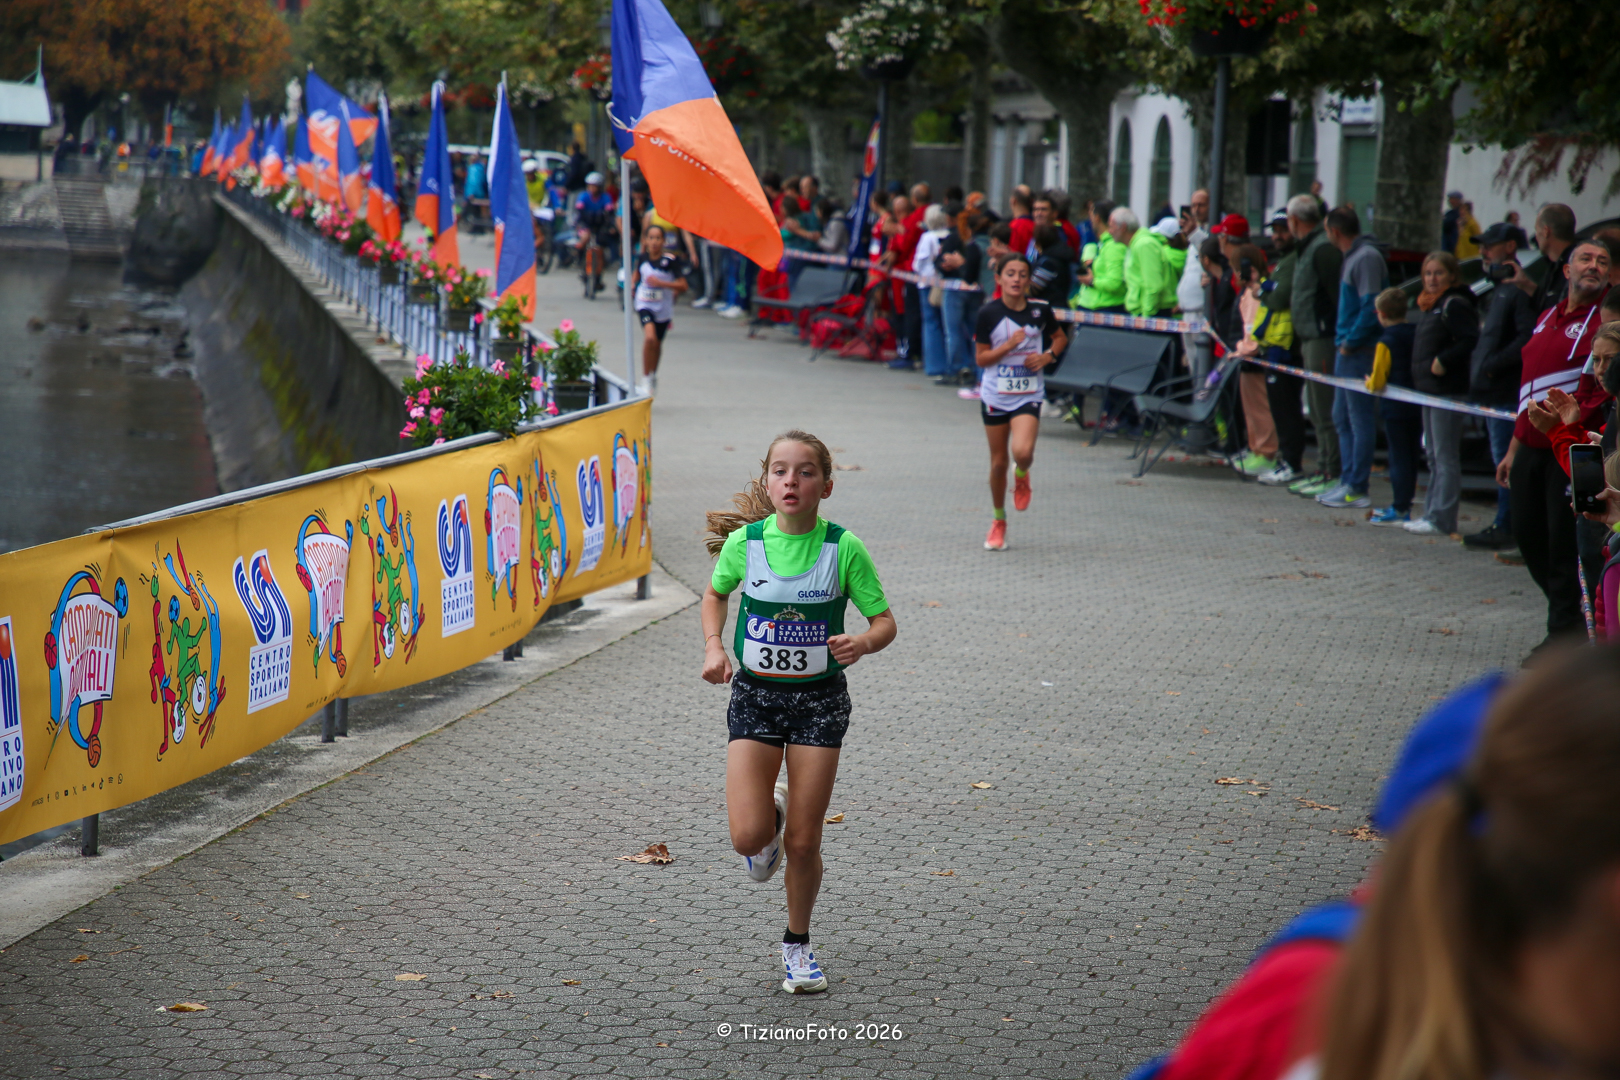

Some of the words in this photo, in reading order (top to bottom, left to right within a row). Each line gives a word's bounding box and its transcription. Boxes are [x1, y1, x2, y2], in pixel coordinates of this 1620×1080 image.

[1006, 378, 1030, 391] 349
[443, 580, 473, 600] CENTRO
[798, 590, 830, 598] GLOBAL
[443, 594, 473, 613] SPORTIVO
[443, 607, 473, 627] ITALIANO
[251, 645, 291, 670] CENTRO
[759, 647, 808, 671] 383
[250, 661, 290, 686] SPORTIVO
[250, 676, 289, 702] ITALIANO
